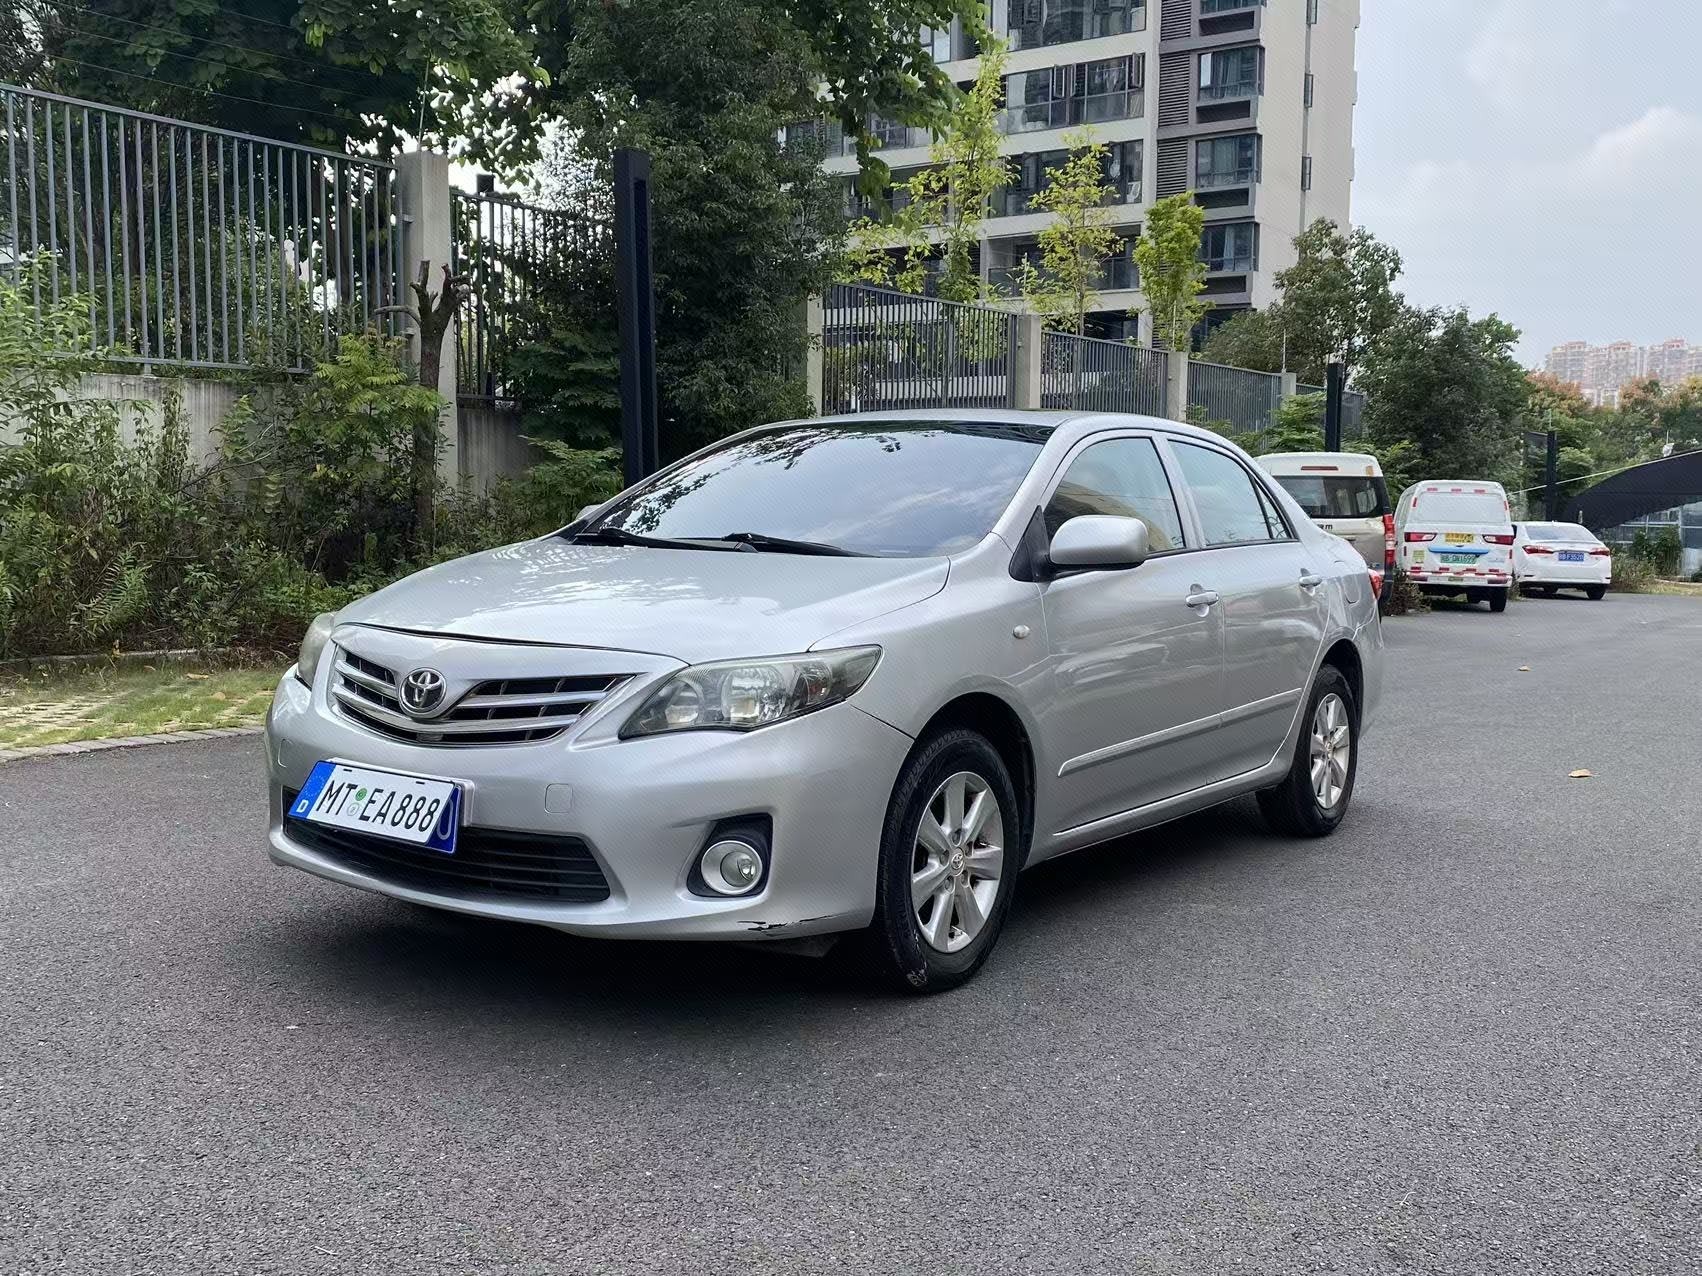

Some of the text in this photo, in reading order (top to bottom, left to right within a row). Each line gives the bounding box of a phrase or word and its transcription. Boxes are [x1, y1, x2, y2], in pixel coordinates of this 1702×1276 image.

[296, 799, 309, 813] D
[316, 780, 357, 816] MT
[359, 788, 441, 833] EA888
